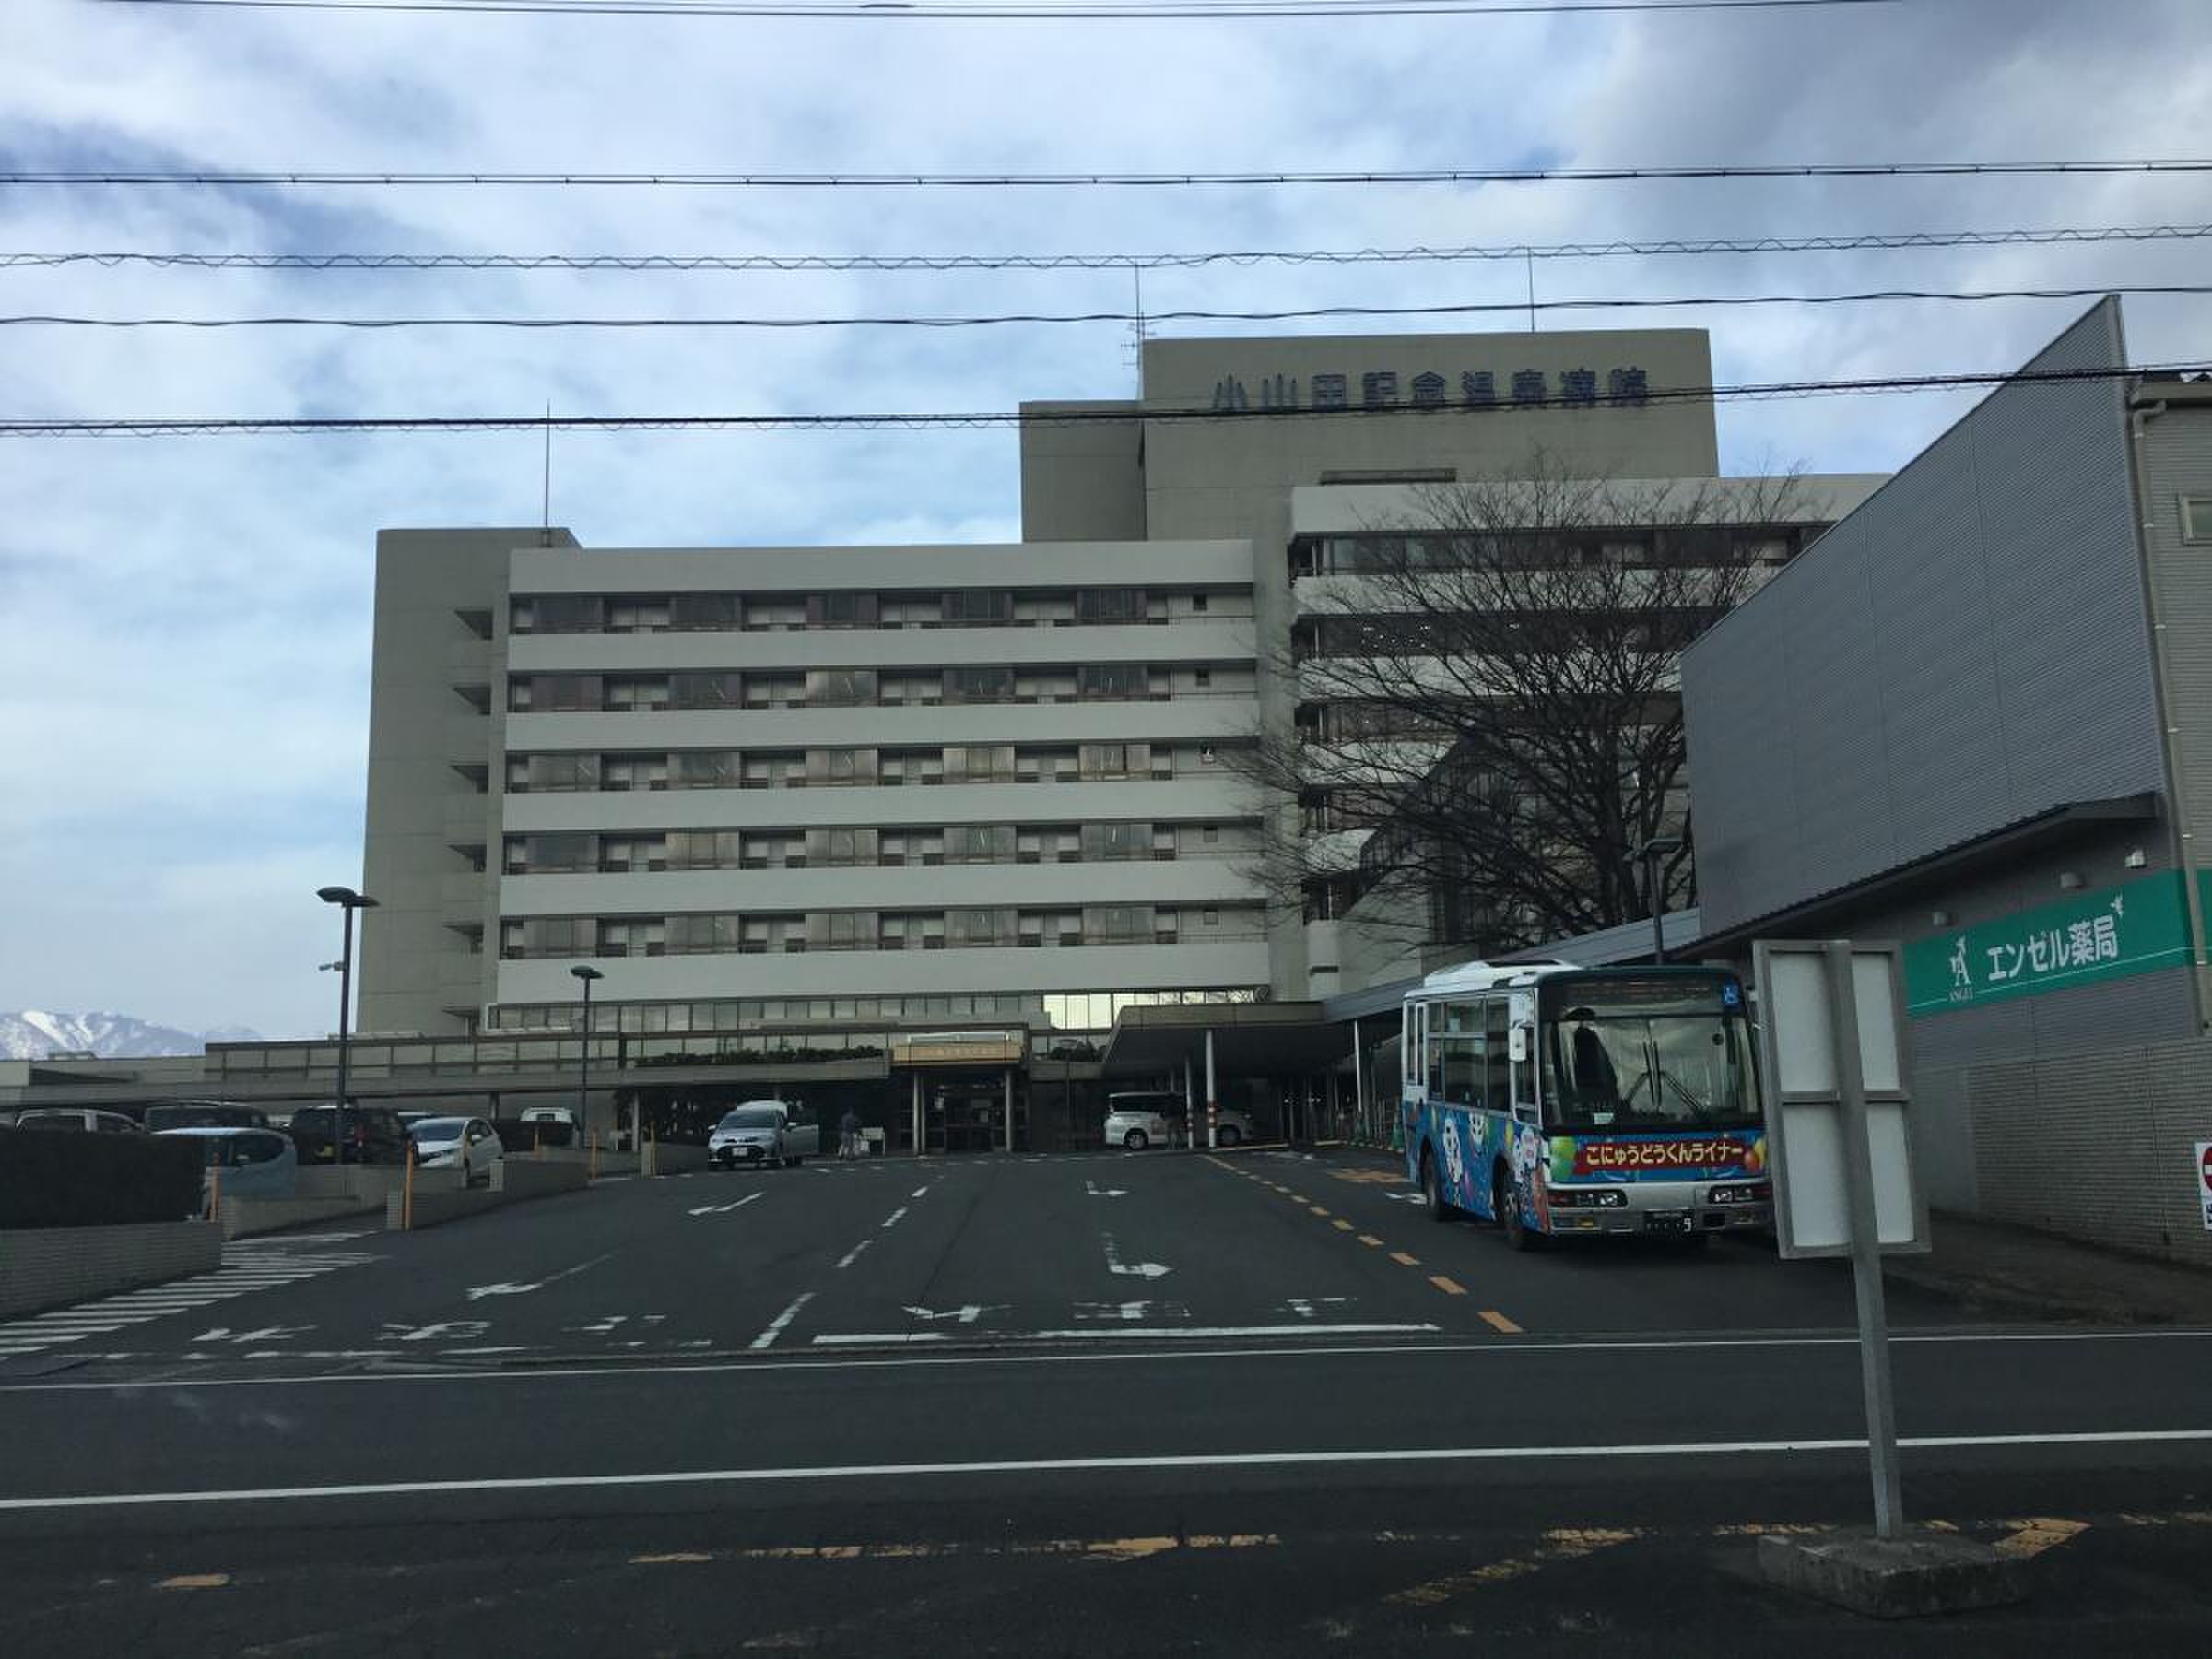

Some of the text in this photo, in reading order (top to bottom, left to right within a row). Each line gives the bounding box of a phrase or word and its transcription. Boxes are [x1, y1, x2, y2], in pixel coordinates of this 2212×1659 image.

[1986, 914, 2119, 981] エンゼル薬局
[1585, 1141, 1744, 1167] こにゅうどうくんライナー
